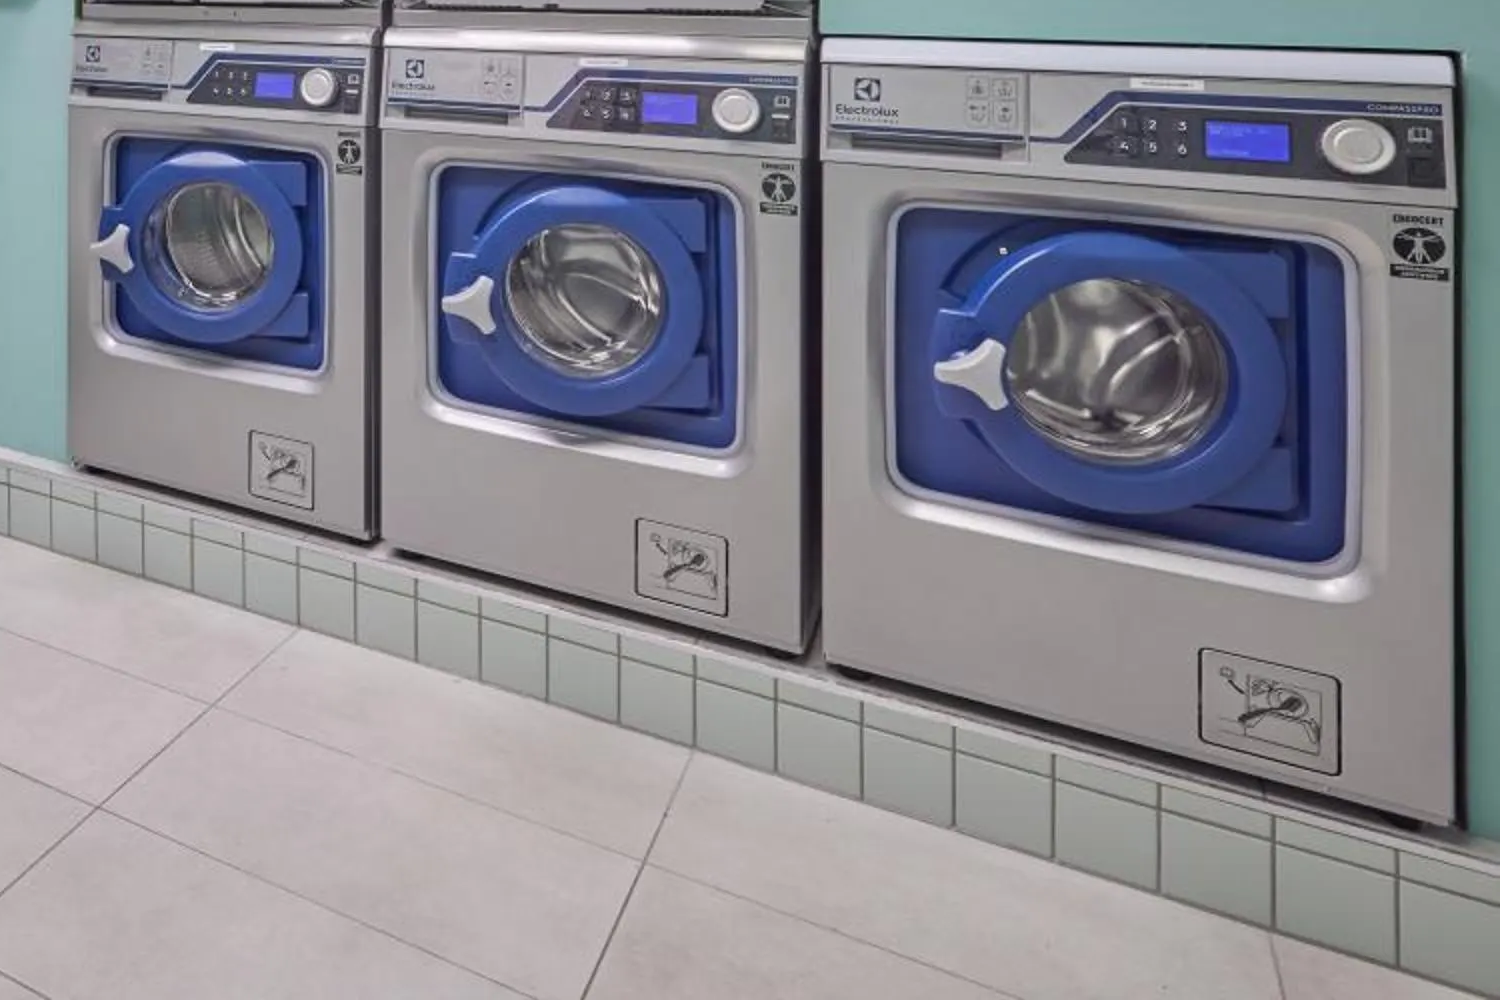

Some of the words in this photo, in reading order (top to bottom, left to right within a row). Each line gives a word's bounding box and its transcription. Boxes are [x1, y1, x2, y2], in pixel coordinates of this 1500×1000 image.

[835, 103, 900, 117] Electrolux
[1148, 119, 1157, 131] 2
[1177, 120, 1188, 132] 3
[1148, 141, 1158, 153] 5
[1176, 143, 1188, 155] 6
